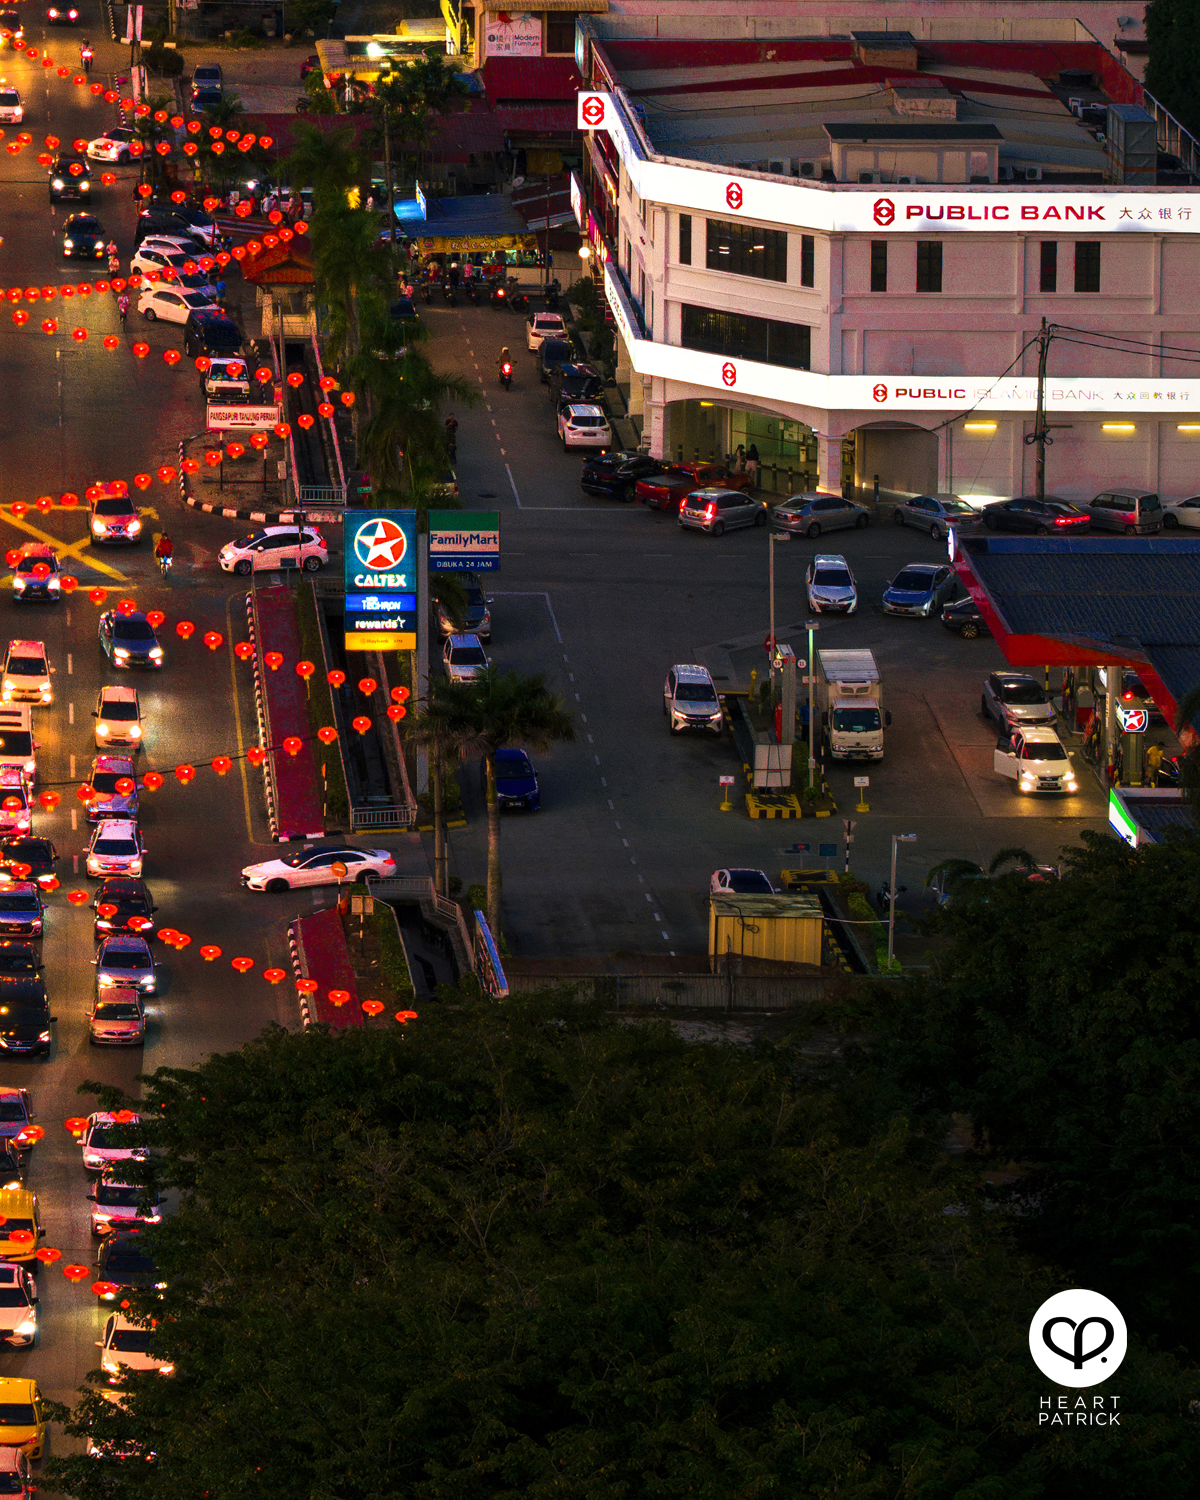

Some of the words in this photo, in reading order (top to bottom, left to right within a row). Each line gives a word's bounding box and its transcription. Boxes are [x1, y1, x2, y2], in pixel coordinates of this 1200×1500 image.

[906, 205, 1009, 220] PUBLIC
[1021, 205, 1106, 220] BANK
[1119, 207, 1192, 220] 大众银行
[895, 388, 966, 399] PUBLIC
[973, 388, 1044, 400] ISLAMIC
[1052, 389, 1105, 400] BANK
[210, 412, 238, 421] PANGSAPURI
[239, 412, 259, 421] TANJUNG
[430, 533, 498, 547] FamilyMart
[354, 574, 407, 587] CALTEX
[361, 600, 401, 611] TECHRON
[355, 619, 398, 629] rewards
